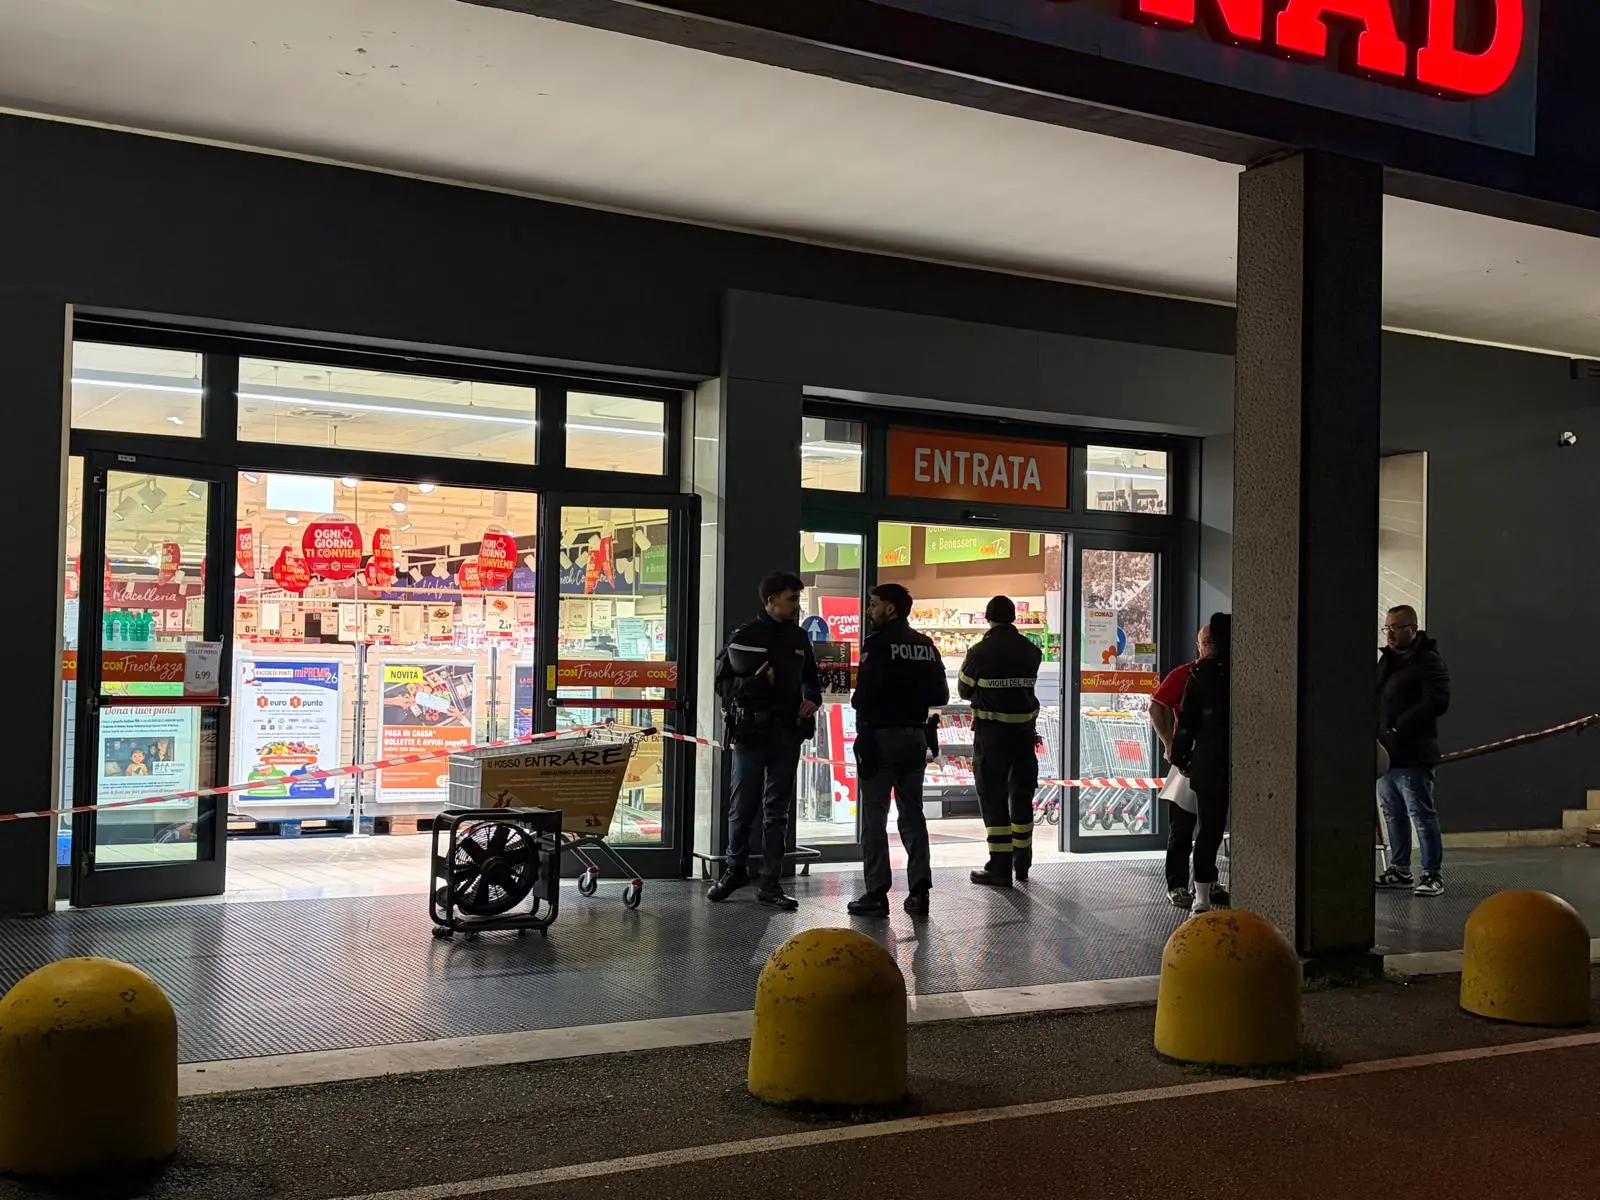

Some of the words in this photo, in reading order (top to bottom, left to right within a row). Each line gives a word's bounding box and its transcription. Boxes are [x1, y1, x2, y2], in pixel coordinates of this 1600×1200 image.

[913, 447, 1042, 492] ENTRATA
[314, 529, 341, 539] OGNI
[314, 539, 354, 549] GIORNO
[931, 543, 937, 551] e
[938, 537, 978, 551] Benessere
[304, 548, 315, 558] TI
[113, 587, 177, 602] Macelleria
[889, 643, 936, 662] POLIZIA
[988, 679, 1008, 687] VIGILI
[1009, 678, 1022, 687] DEL
[302, 699, 324, 708] punto
[384, 729, 402, 737] PAGA
[494, 759, 521, 768] POSSO
[524, 747, 627, 767] ENTRARE
